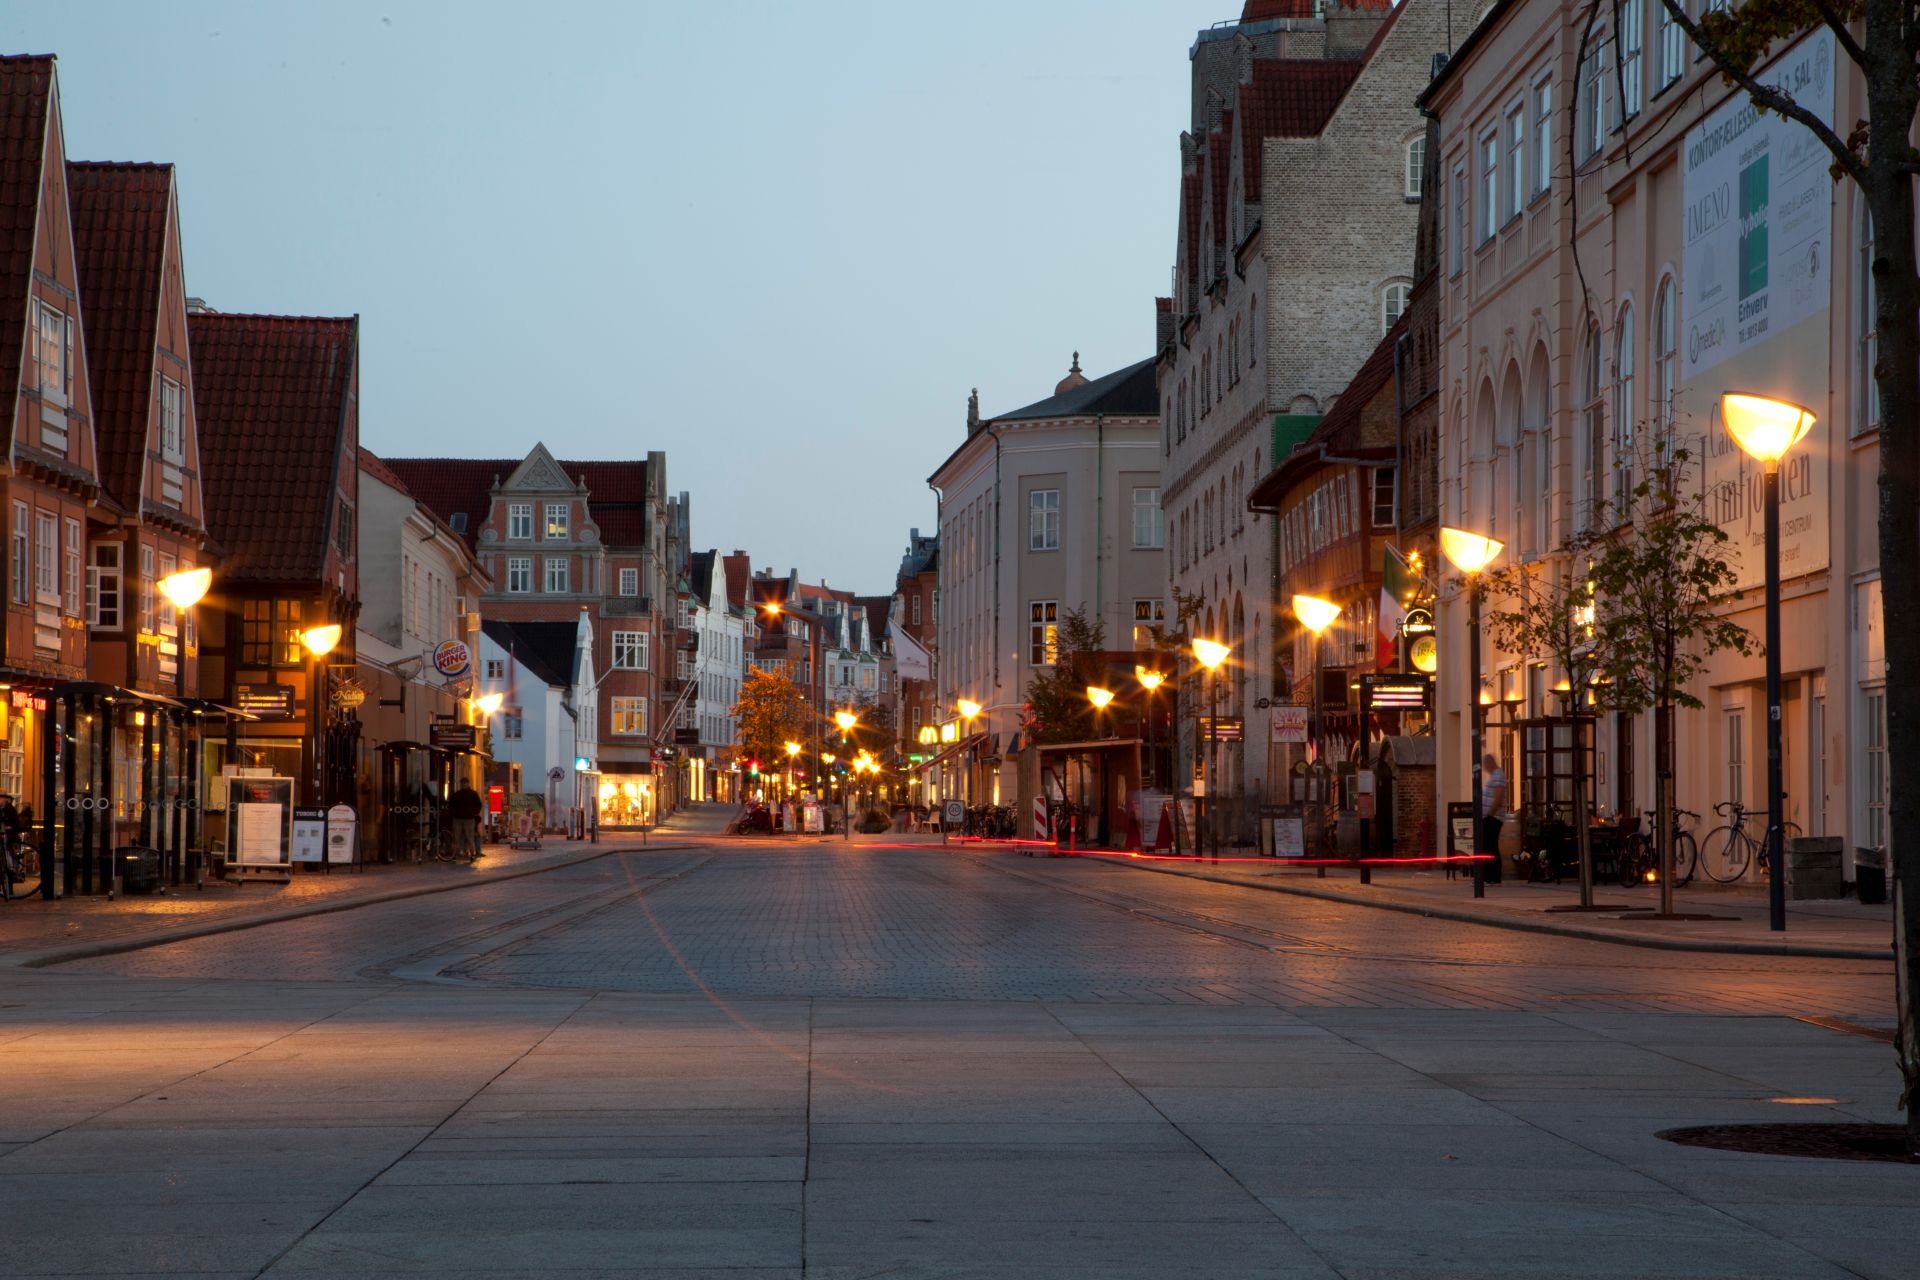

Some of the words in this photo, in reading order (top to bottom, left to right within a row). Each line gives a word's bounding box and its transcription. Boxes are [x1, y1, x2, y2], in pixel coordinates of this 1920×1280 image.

[1688, 102, 1762, 173] KONTORFÆLLESSK
[1794, 58, 1812, 94] SAL
[1687, 181, 1731, 242] IMENO
[1736, 202, 1769, 241] Nybolig
[1738, 292, 1769, 324] Erhverv
[1700, 434, 1812, 537] Limfjoden
[1784, 513, 1812, 537] CENTRUM
[436, 645, 465, 661] BURGER
[438, 652, 467, 671] KING
